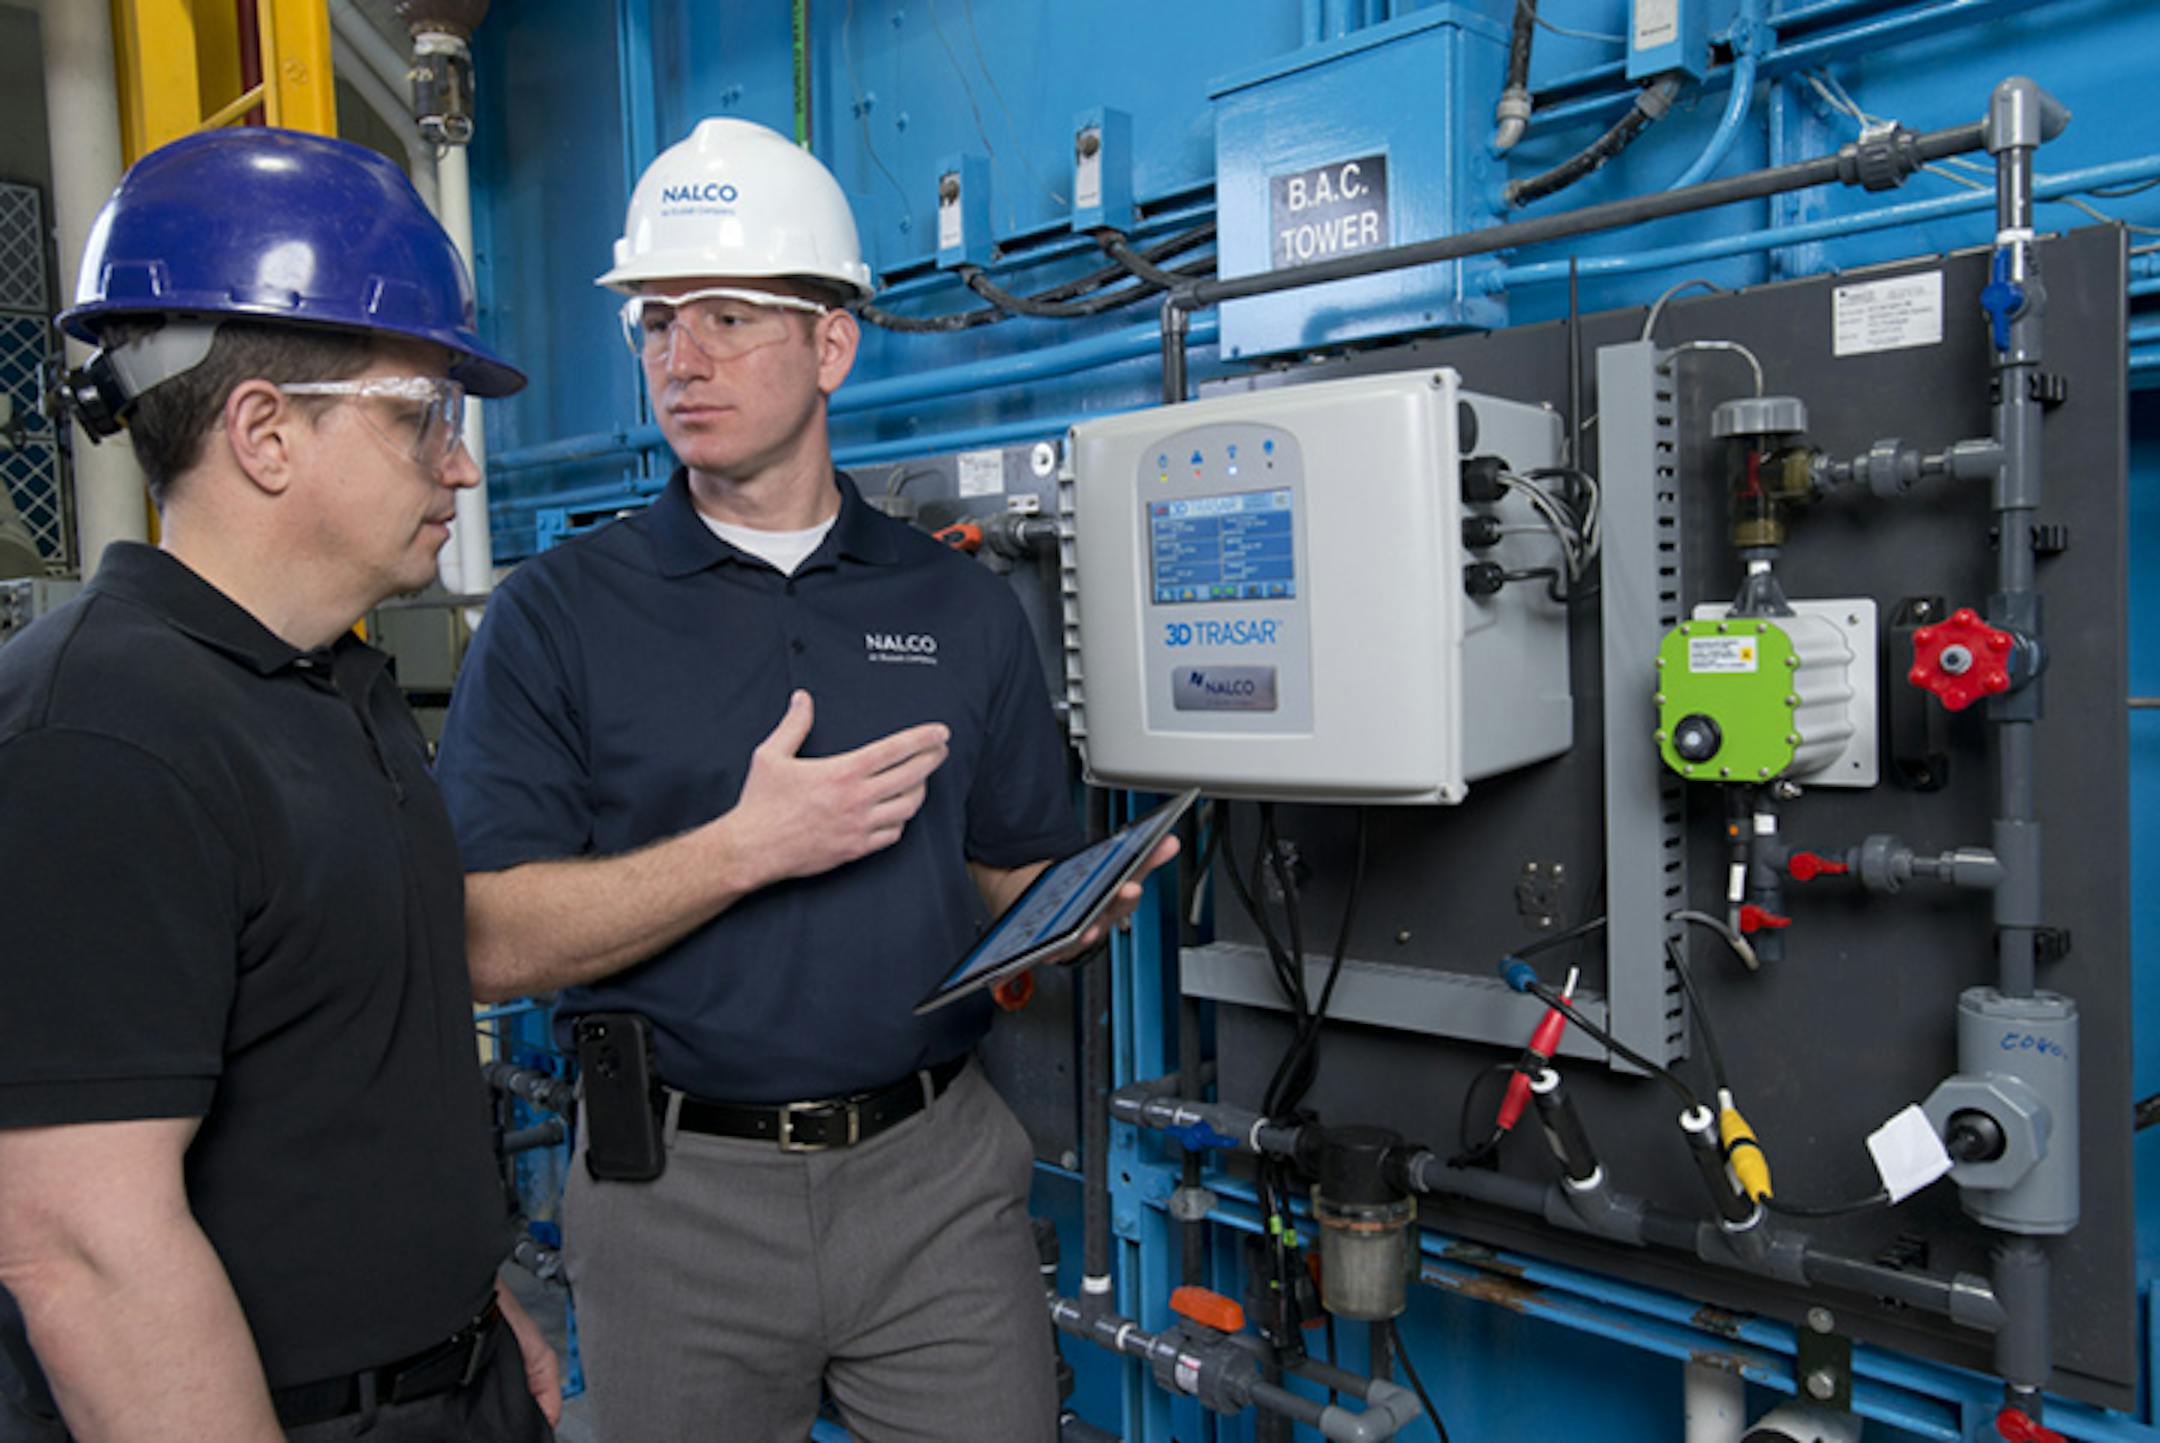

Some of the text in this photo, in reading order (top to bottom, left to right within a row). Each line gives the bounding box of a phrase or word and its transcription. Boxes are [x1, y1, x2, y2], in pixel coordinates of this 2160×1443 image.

[662, 183, 738, 204] NALCO
[1288, 163, 1369, 211] B.A.C.
[1280, 210, 1379, 261] TOWER
[864, 634, 938, 653] NALCO
[1165, 619, 1276, 646] 3D TRASAR
[1206, 680, 1254, 696] NALCO
